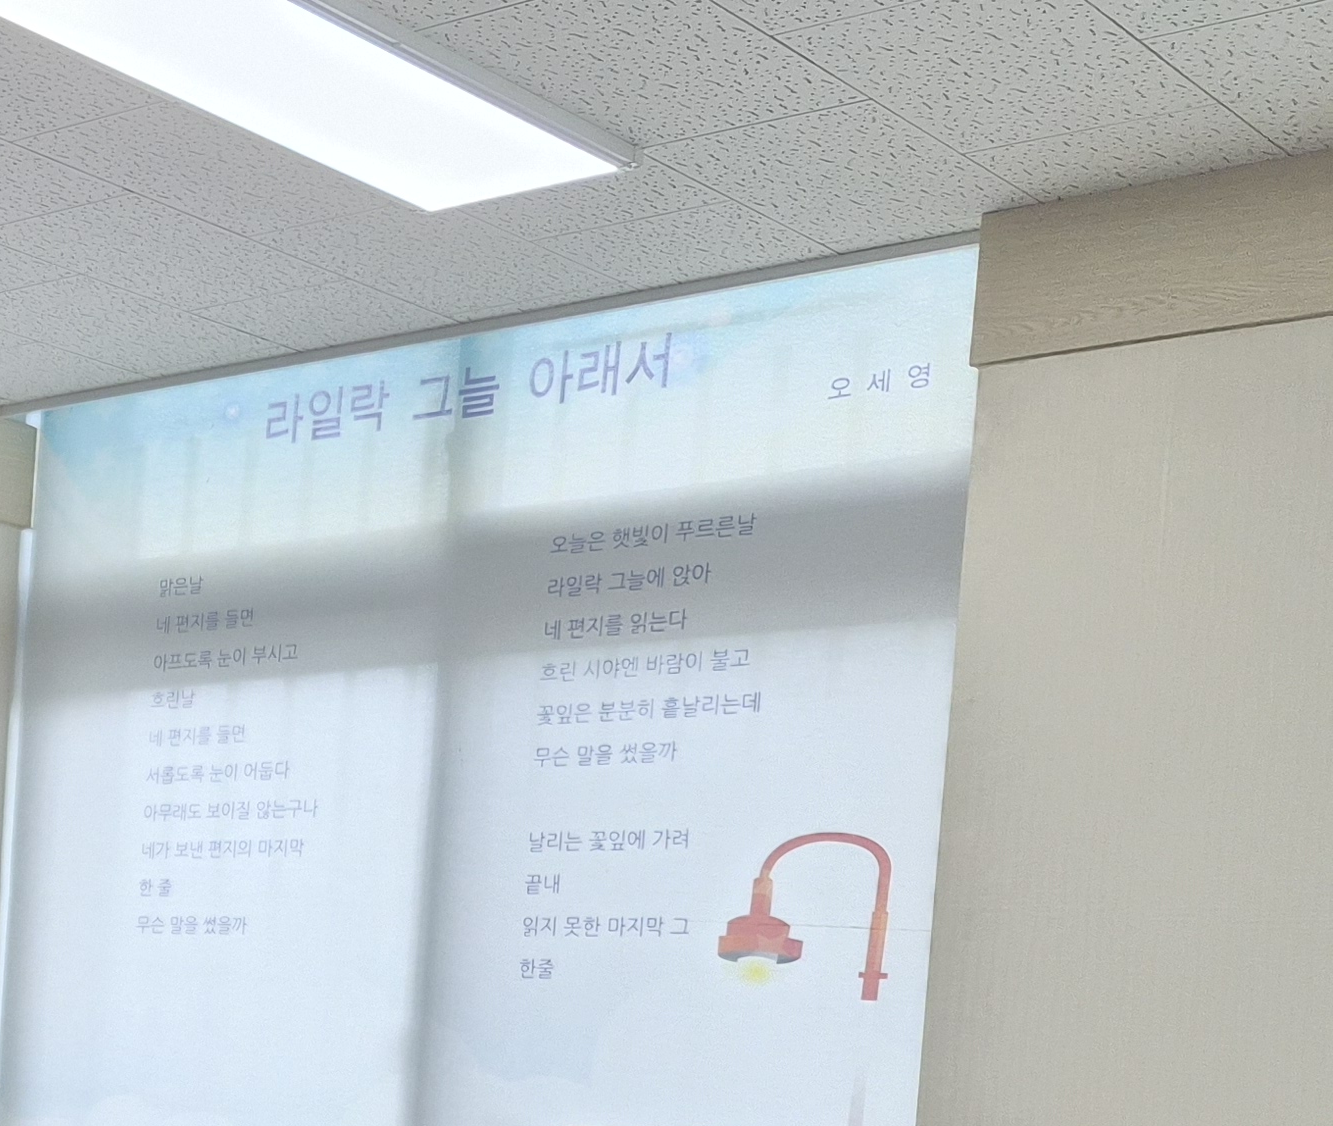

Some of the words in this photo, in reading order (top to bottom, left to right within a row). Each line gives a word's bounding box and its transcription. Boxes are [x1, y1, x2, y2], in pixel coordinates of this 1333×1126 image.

[265, 379, 390, 444] 라일락
[411, 366, 500, 423] 그늘
[528, 332, 673, 404] 아래서
[549, 530, 606, 554] 오늘은
[612, 523, 669, 549] 햇빛이
[675, 513, 757, 542] 푸르른날
[159, 576, 204, 597] 맑은날
[547, 573, 603, 597] 라일락
[607, 566, 665, 591] 그늘에
[672, 562, 712, 586] 앉아
[156, 616, 170, 634] 네
[175, 611, 220, 634] 편지를
[225, 608, 254, 629] 들면
[544, 619, 561, 640] 네
[567, 614, 623, 639] 편지를
[630, 608, 687, 634] 읽는다
[154, 651, 212, 672] 아프도록
[217, 647, 247, 668] 눈이
[251, 644, 299, 664] 부시고
[539, 661, 576, 683] 흐린
[583, 656, 639, 679] 시야엔
[646, 650, 703, 676] 바람이
[710, 648, 751, 672] 불고
[150, 689, 195, 709] 흐린날
[536, 702, 592, 726] 꽃잎은
[598, 698, 655, 722] 분분히
[149, 729, 163, 747] 네
[168, 726, 212, 747] 편지를
[216, 724, 246, 745] 들면
[533, 746, 570, 767] 무슨
[577, 744, 613, 766] 말을
[619, 740, 678, 764] 썼을까
[209, 763, 238, 783] 눈이
[243, 760, 290, 781] 어둡다
[143, 803, 202, 822] 아무래도
[205, 800, 251, 821] 보이질
[256, 798, 318, 820] 않는구나
[141, 841, 170, 860] 네가
[174, 841, 203, 859] 보낸
[207, 839, 252, 859] 편지의
[258, 838, 304, 858] 마지막
[529, 830, 583, 853] 날리는
[588, 829, 646, 852] 꽃잎에
[652, 828, 690, 850] 가려
[139, 878, 153, 897] 한
[157, 878, 172, 897] 줄
[524, 873, 561, 895] 끝내
[136, 916, 165, 934] 무슨
[170, 915, 198, 935] 말을
[202, 915, 248, 935] 썼을까
[522, 916, 557, 937] 읽지
[563, 916, 601, 937] 못한
[608, 916, 664, 937] 마지막
[669, 917, 690, 936] 그
[519, 958, 554, 980] 한줄
